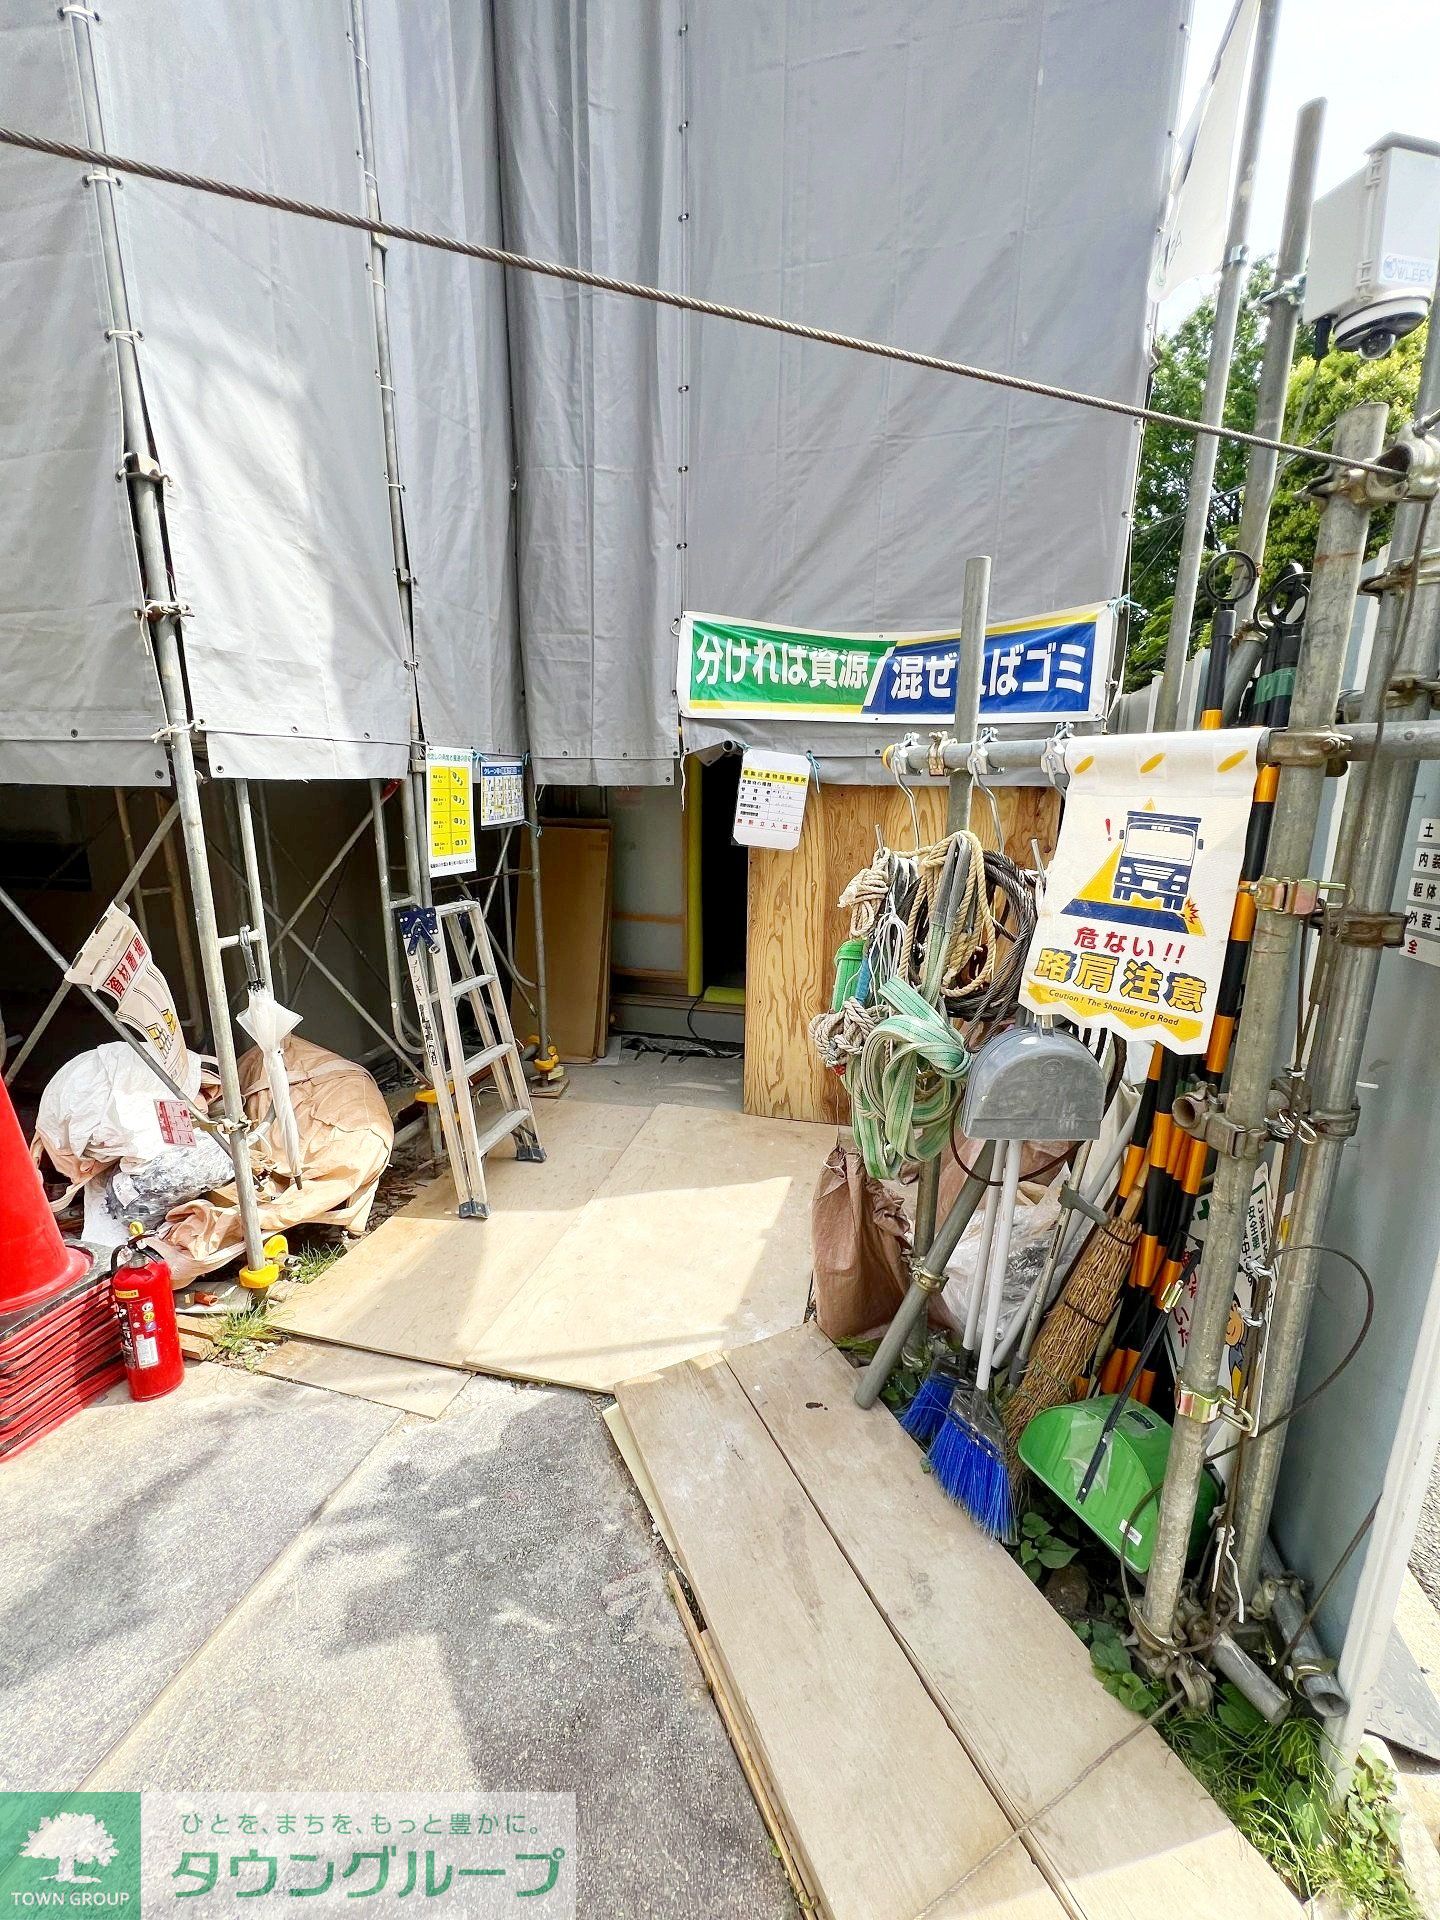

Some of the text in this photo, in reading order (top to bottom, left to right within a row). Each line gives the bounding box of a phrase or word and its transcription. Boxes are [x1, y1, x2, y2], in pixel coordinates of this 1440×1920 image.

[695, 634, 1087, 699] 分ければ資源 混ぜばゴミ
[1034, 947, 1207, 1013] 路肩注意
[1049, 989, 1079, 1003] Caution
[1087, 998, 1101, 1007] The
[1103, 1002, 1138, 1016] Shoulder
[1140, 1011, 1149, 1019] of
[1157, 1014, 1179, 1026] Road
